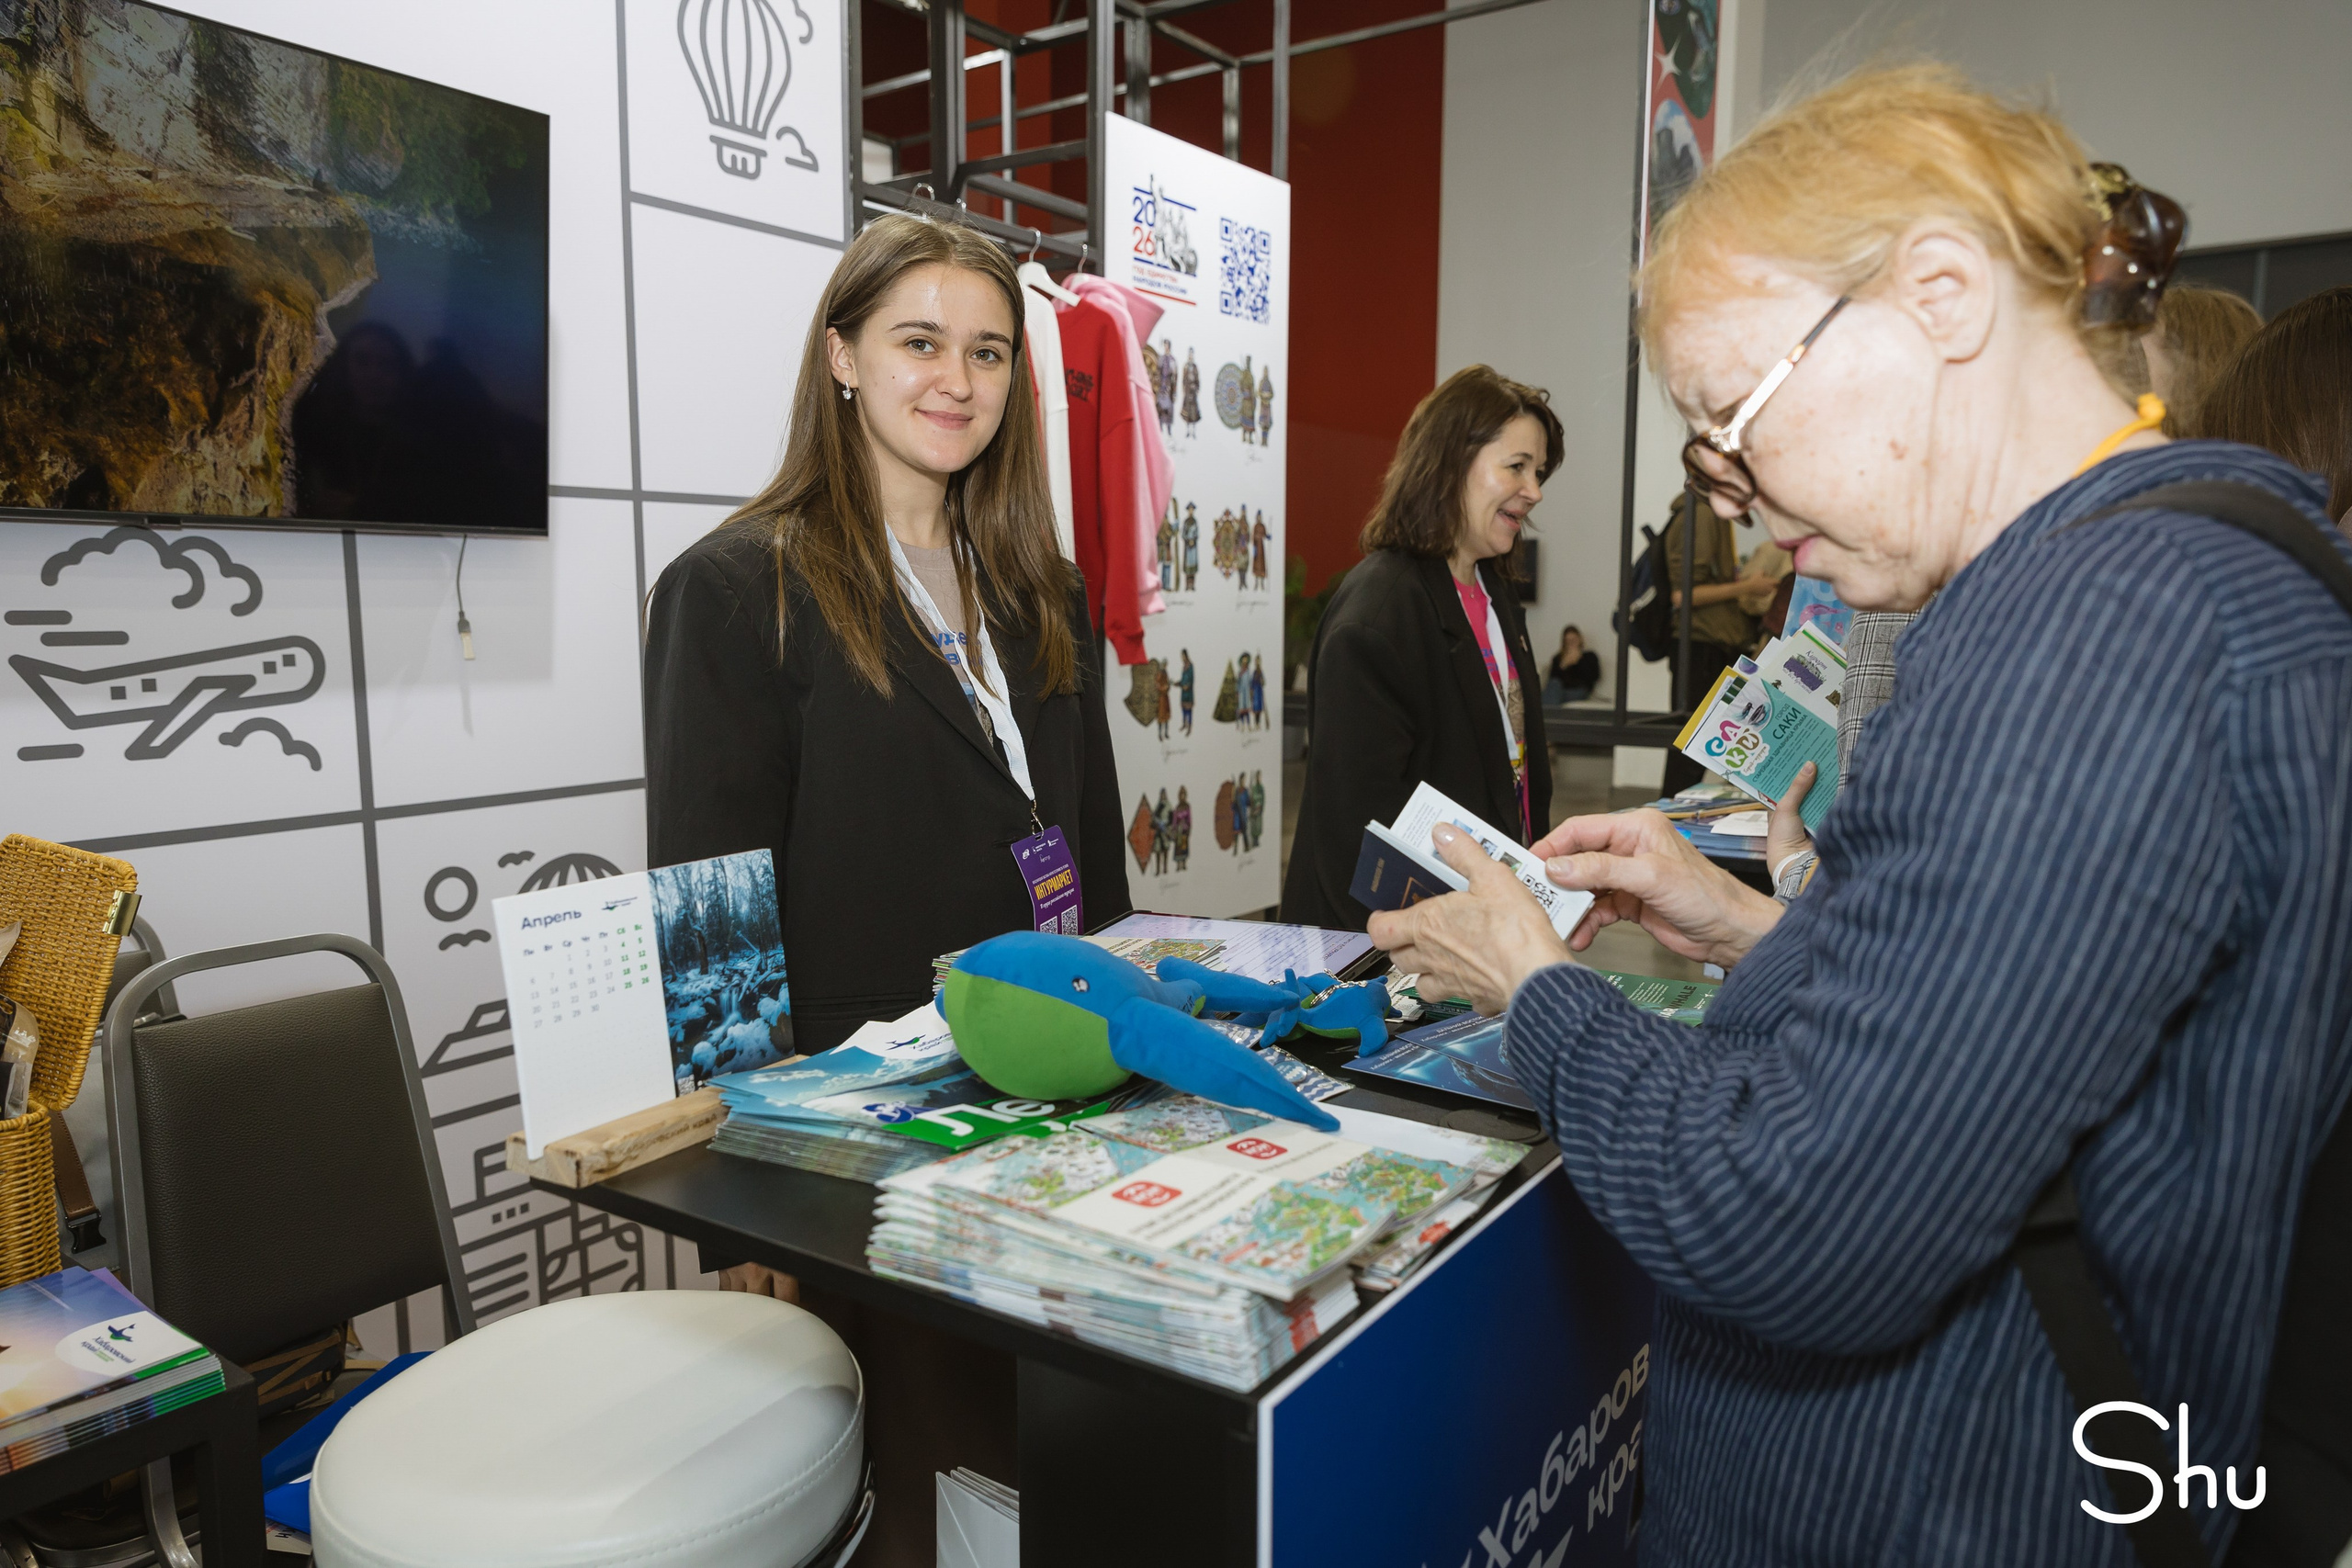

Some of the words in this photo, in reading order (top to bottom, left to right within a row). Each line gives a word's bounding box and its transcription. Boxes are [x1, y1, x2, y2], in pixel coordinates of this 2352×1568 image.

[1133, 196, 1156, 227] 20
[1133, 226, 1155, 255] 26
[1772, 707, 1802, 739] САКИ
[1775, 703, 1791, 720] ГОРОД
[1772, 730, 1795, 758] ЗДРАВНИЦА
[1792, 714, 1808, 733] КРЫМА
[1035, 869, 1074, 900] ИНТУРМАРКЕТ
[522, 909, 582, 930] Апрель
[1477, 1343, 1650, 1568] Хабаров
[1588, 1419, 1642, 1534] кра
